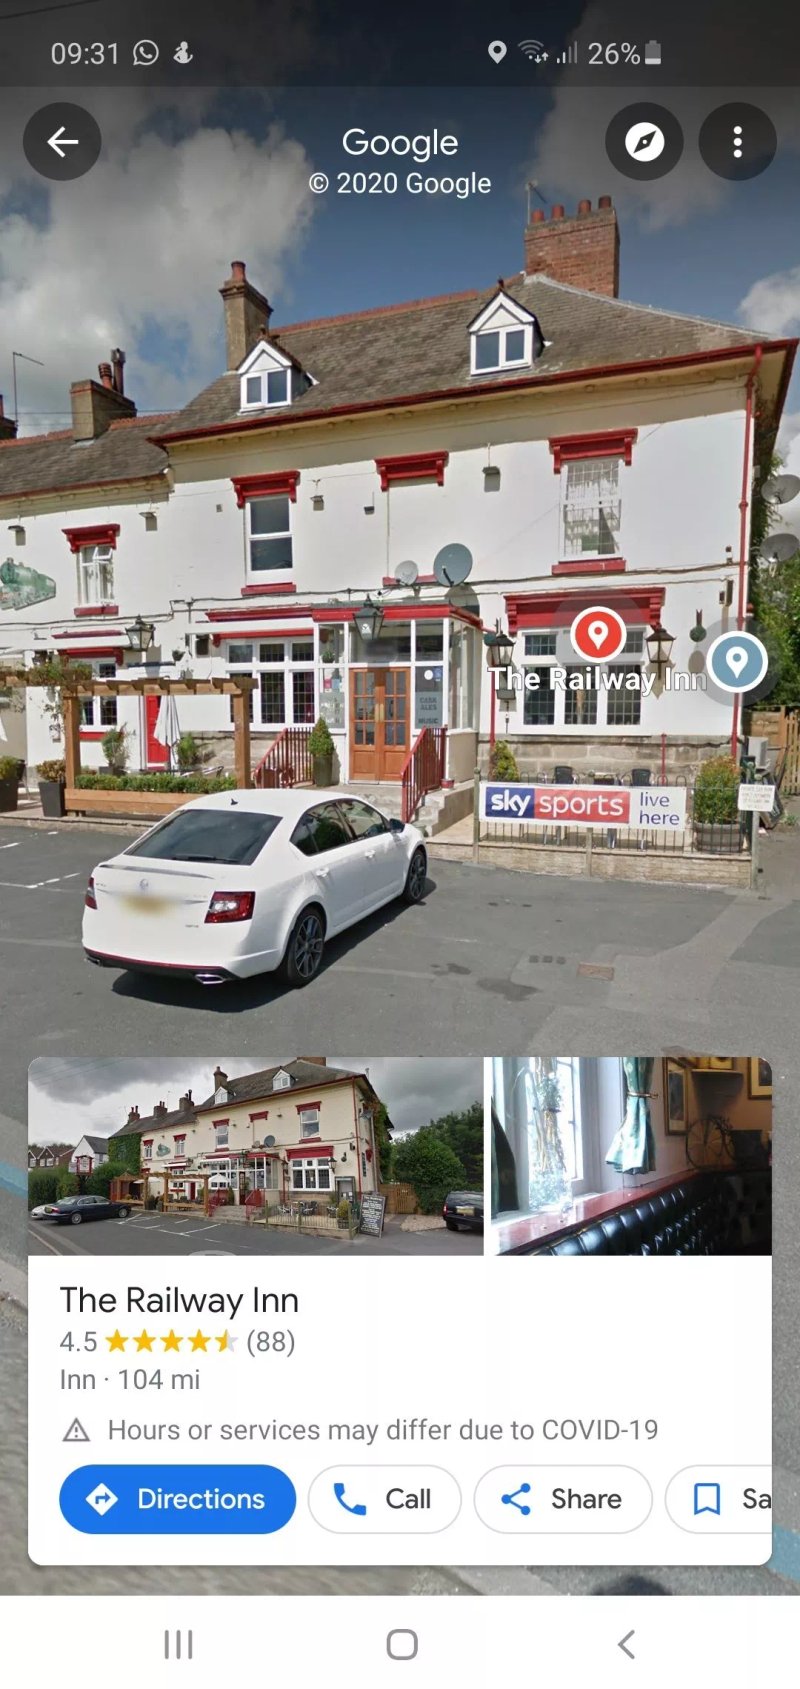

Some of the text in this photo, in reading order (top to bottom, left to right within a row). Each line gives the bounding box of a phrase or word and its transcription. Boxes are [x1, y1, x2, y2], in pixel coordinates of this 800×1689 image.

[491, 789, 624, 817] sky sports
[640, 792, 670, 807] live
[639, 811, 680, 825] here
